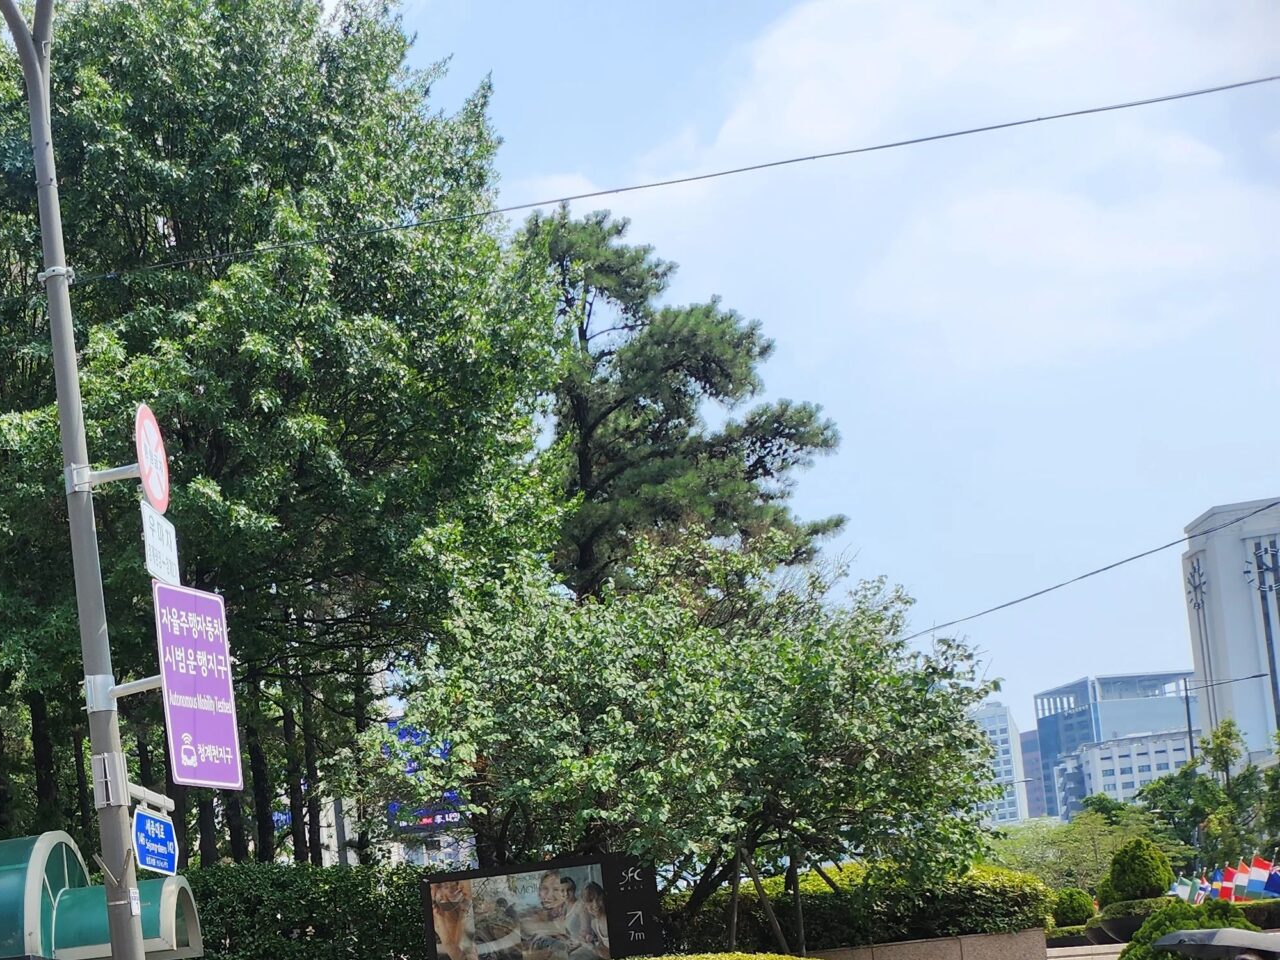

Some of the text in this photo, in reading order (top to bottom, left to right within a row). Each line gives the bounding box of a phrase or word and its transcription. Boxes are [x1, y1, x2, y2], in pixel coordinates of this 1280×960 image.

[161, 606, 223, 643] 자율주행자동차
[165, 645, 227, 680] 시범운행지구
[169, 689, 232, 715] Autonomous Mobility Testbed
[197, 744, 233, 765] 청계천지구
[628, 930, 645, 941] 7m
